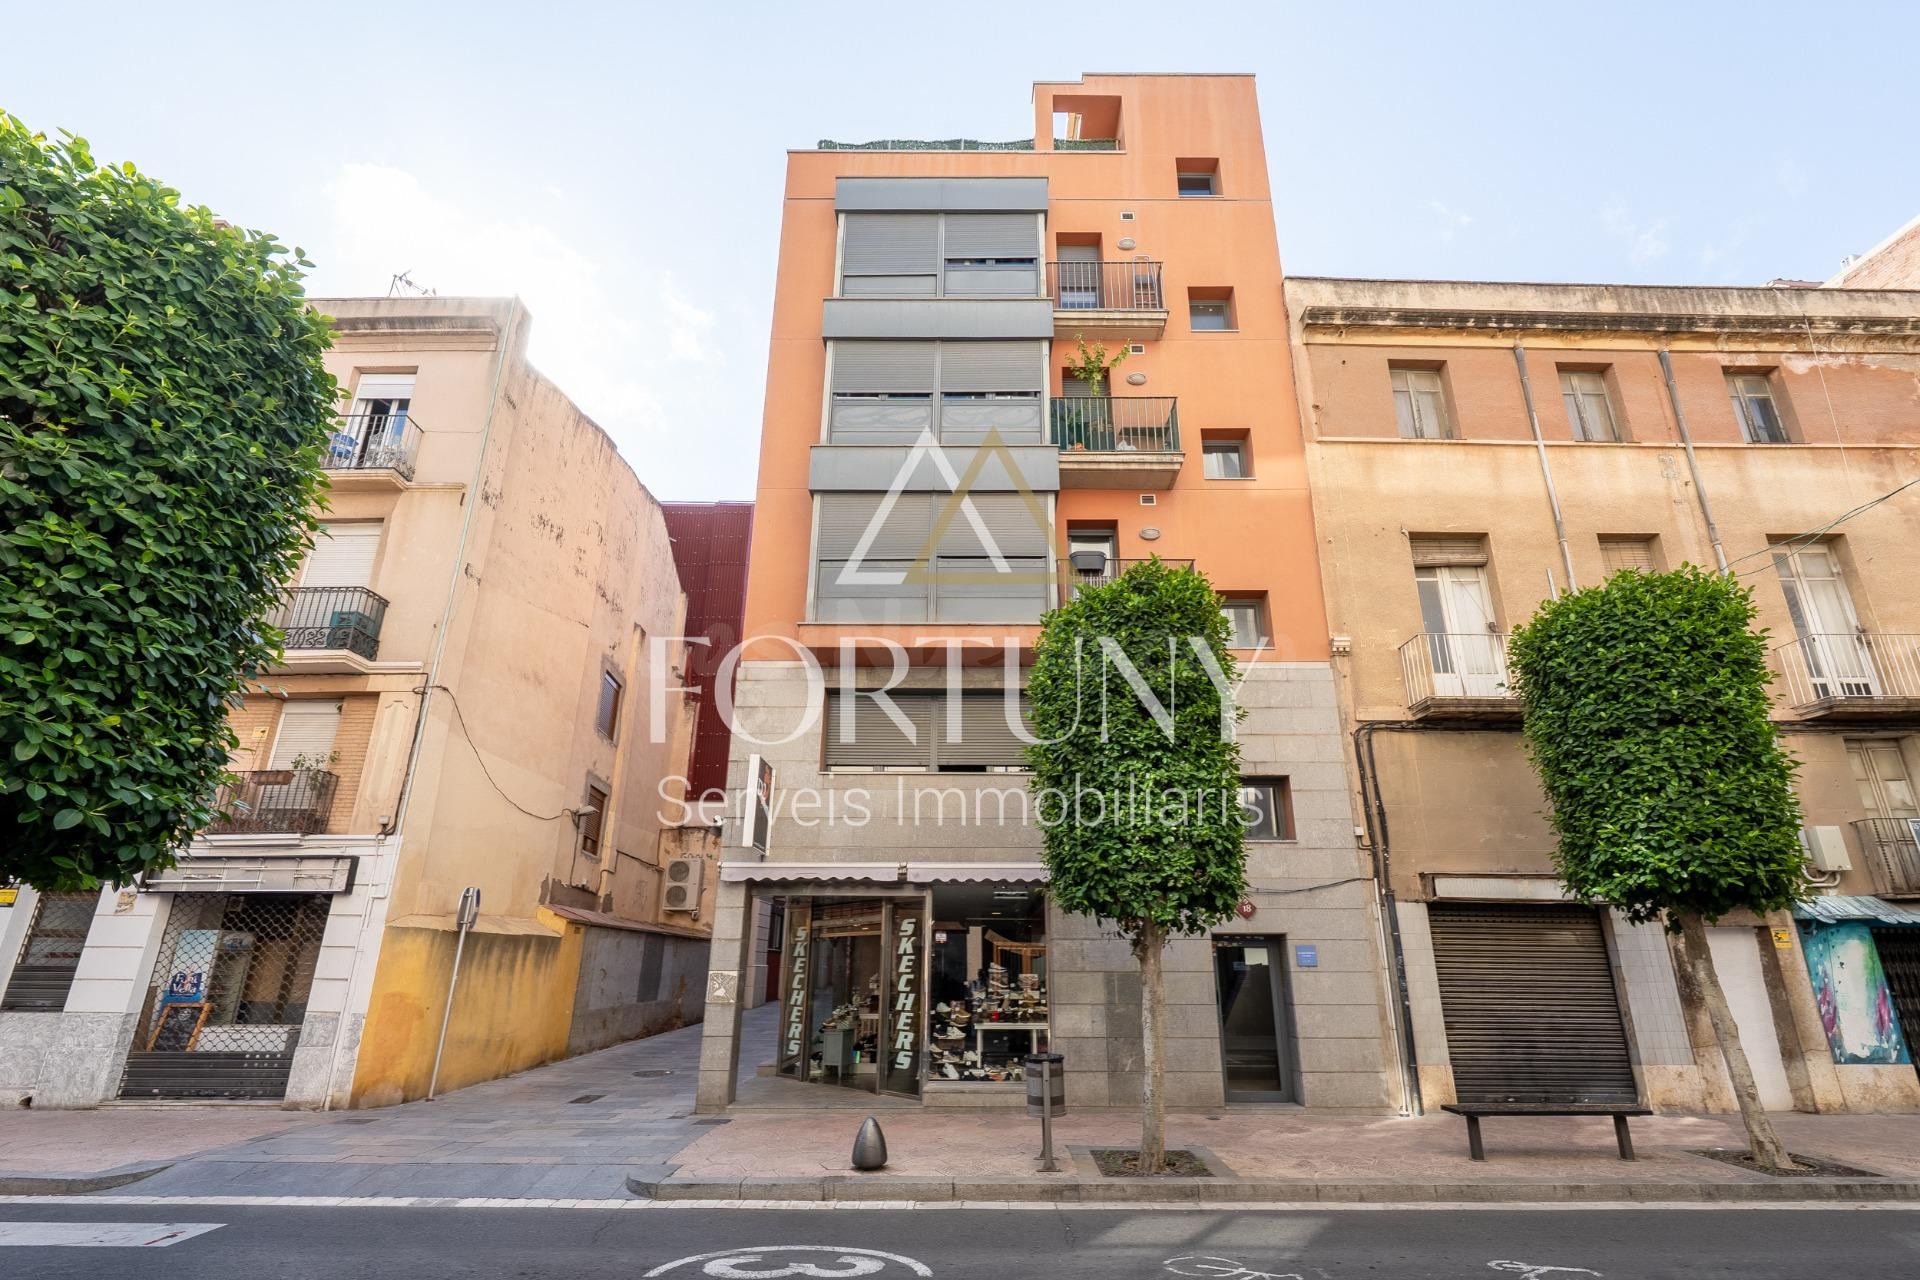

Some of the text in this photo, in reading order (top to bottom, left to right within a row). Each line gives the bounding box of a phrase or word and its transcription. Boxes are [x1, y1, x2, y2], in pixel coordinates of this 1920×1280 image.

[1242, 904, 1252, 913] 18
[787, 926, 807, 1056] SKECHERS
[894, 918, 917, 1070] SKECHERS
